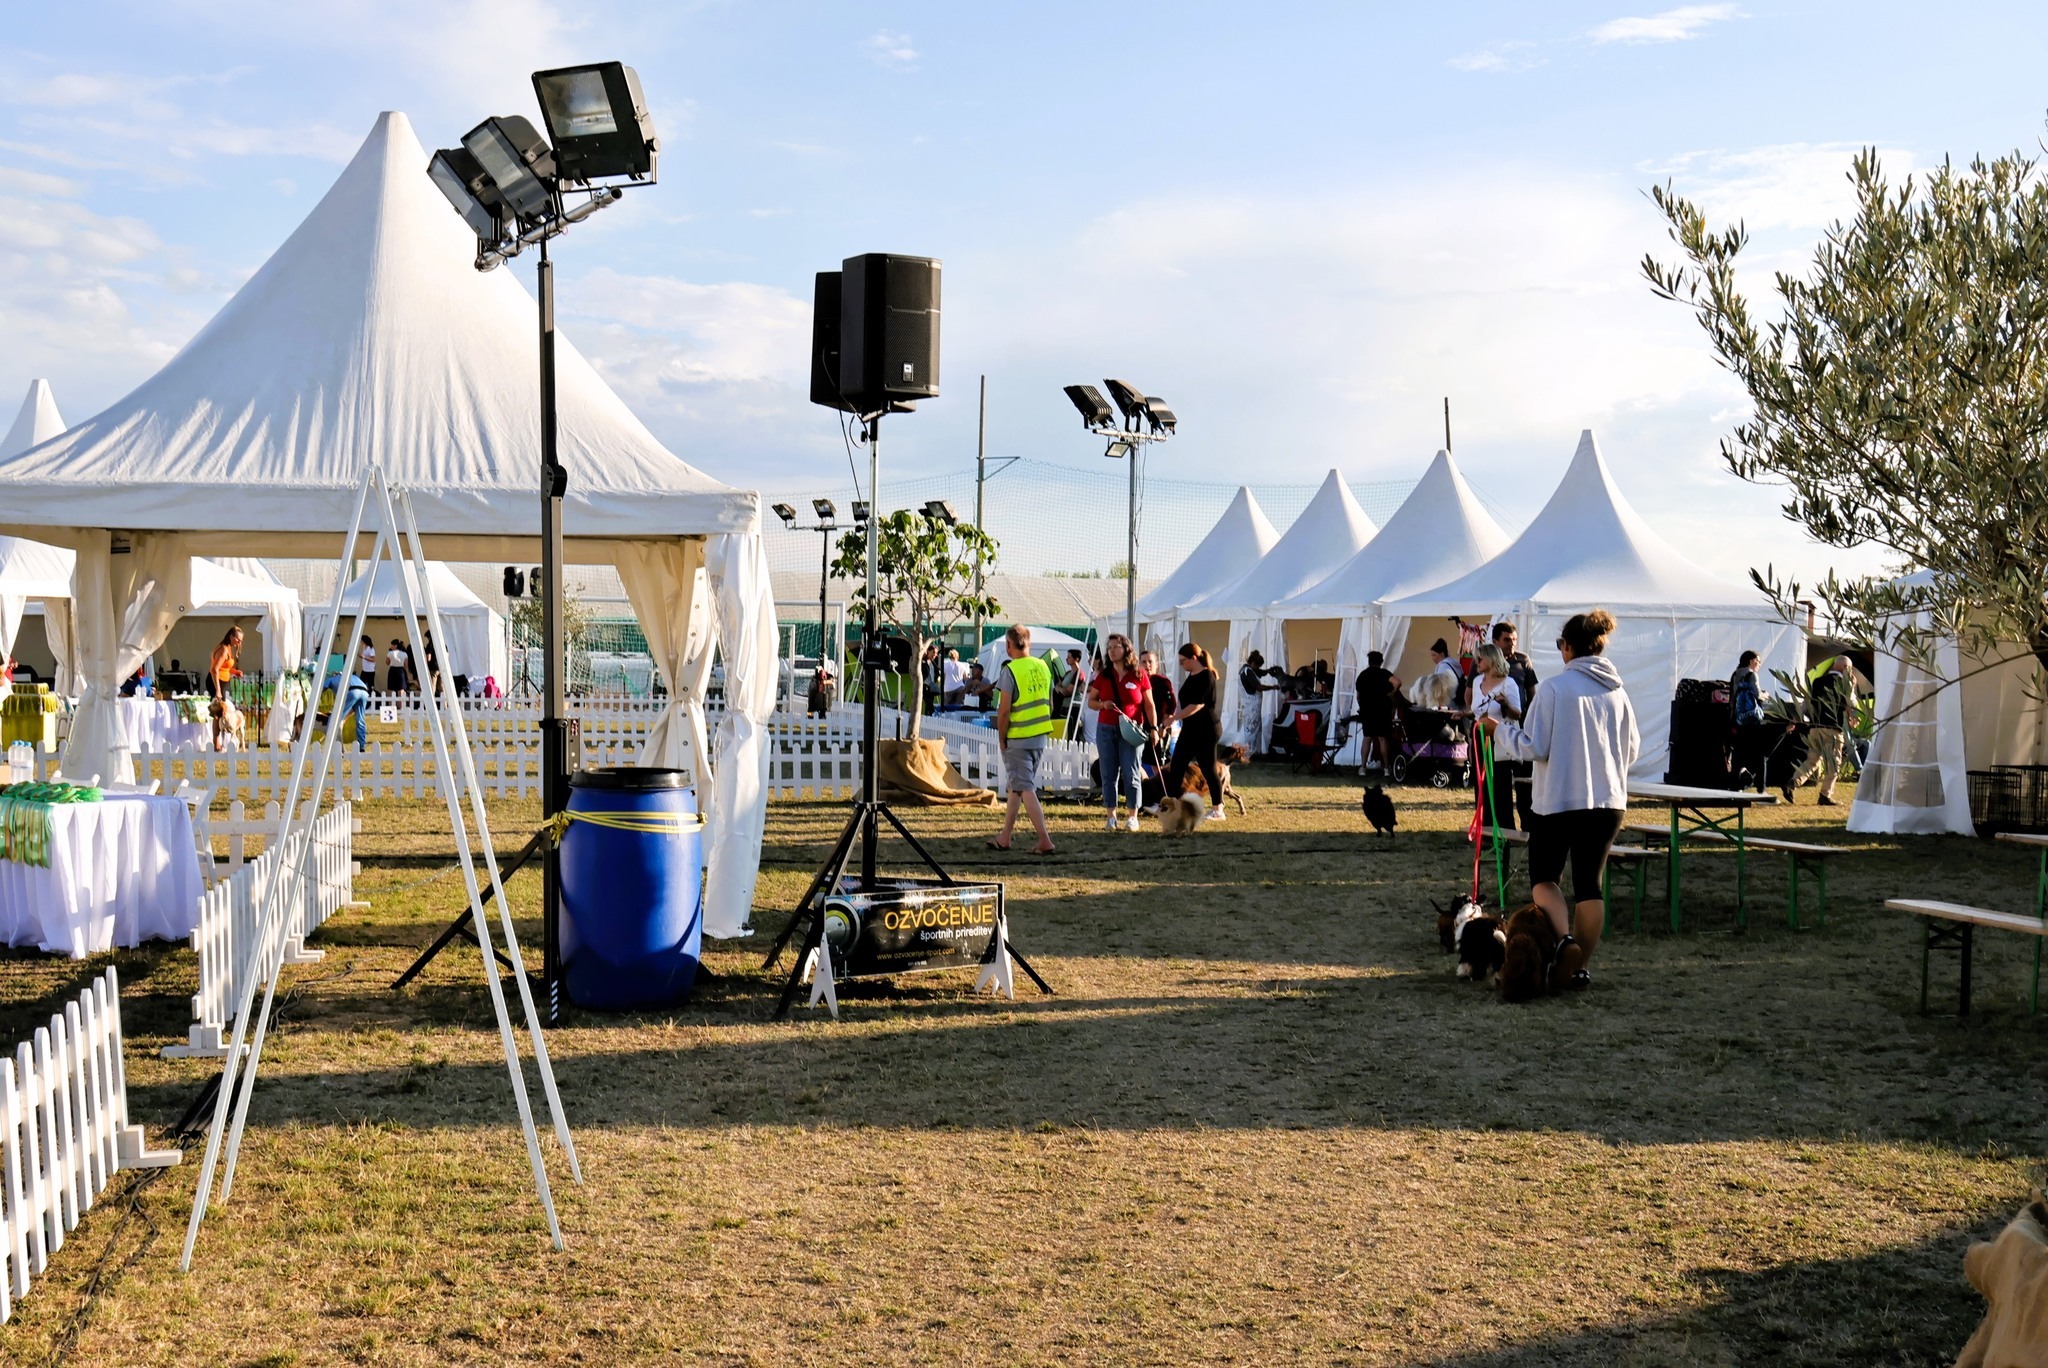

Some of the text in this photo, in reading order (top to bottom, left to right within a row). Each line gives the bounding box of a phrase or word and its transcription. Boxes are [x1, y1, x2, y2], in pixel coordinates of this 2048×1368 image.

[383, 710, 393, 721] 3
[884, 904, 993, 930] OZVOČENJE
[920, 926, 993, 942] športnih prireditev
[877, 947, 956, 960] wwwozvocenje-sport.com
